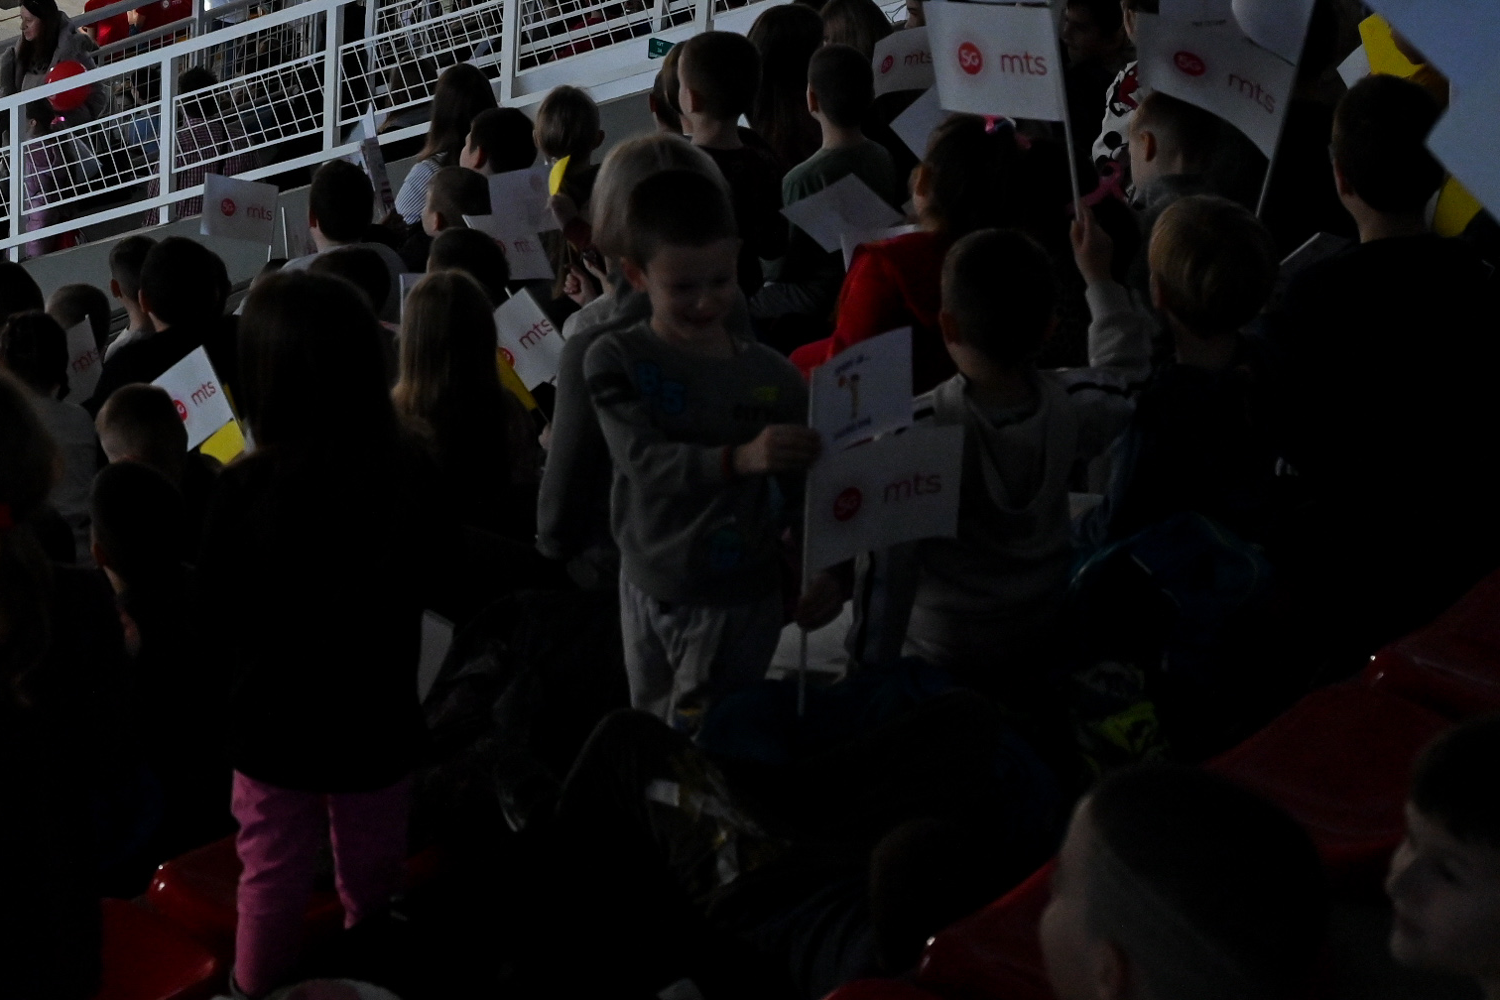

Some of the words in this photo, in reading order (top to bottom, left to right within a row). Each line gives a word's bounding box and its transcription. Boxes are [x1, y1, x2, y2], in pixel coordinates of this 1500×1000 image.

[961, 50, 982, 66] 5G
[1001, 50, 1048, 76] mts
[1229, 74, 1276, 115] mts
[246, 205, 273, 222] mts
[519, 318, 554, 350] mts
[191, 380, 216, 407] mts
[884, 472, 941, 504] mts
